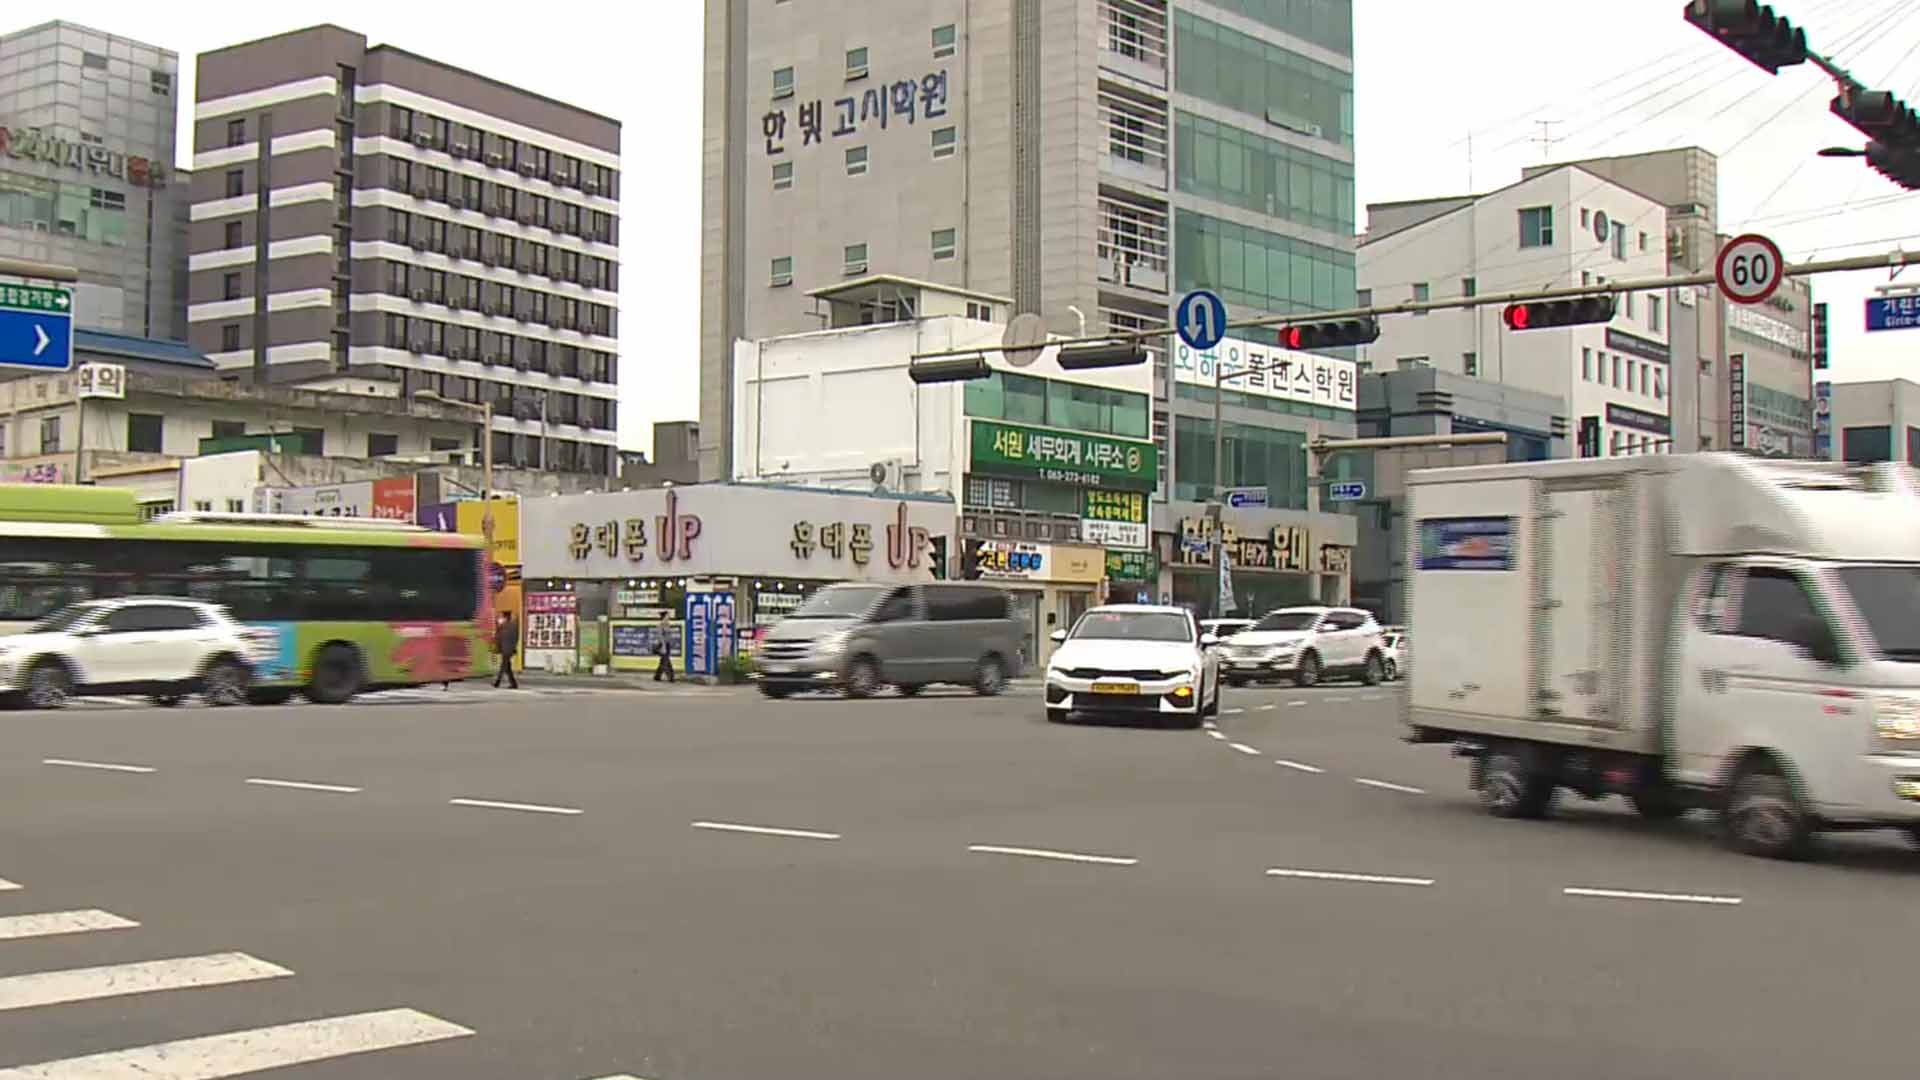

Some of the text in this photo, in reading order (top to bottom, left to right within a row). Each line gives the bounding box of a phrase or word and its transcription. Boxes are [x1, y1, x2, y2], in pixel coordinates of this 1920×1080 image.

[1733, 254, 1767, 286] 60
[993, 430, 1124, 470] 서원 세무회계 사무소
[568, 490, 702, 562] 휴대폰 UP
[790, 521, 875, 565] 휴대폰
[886, 503, 932, 569] UP
